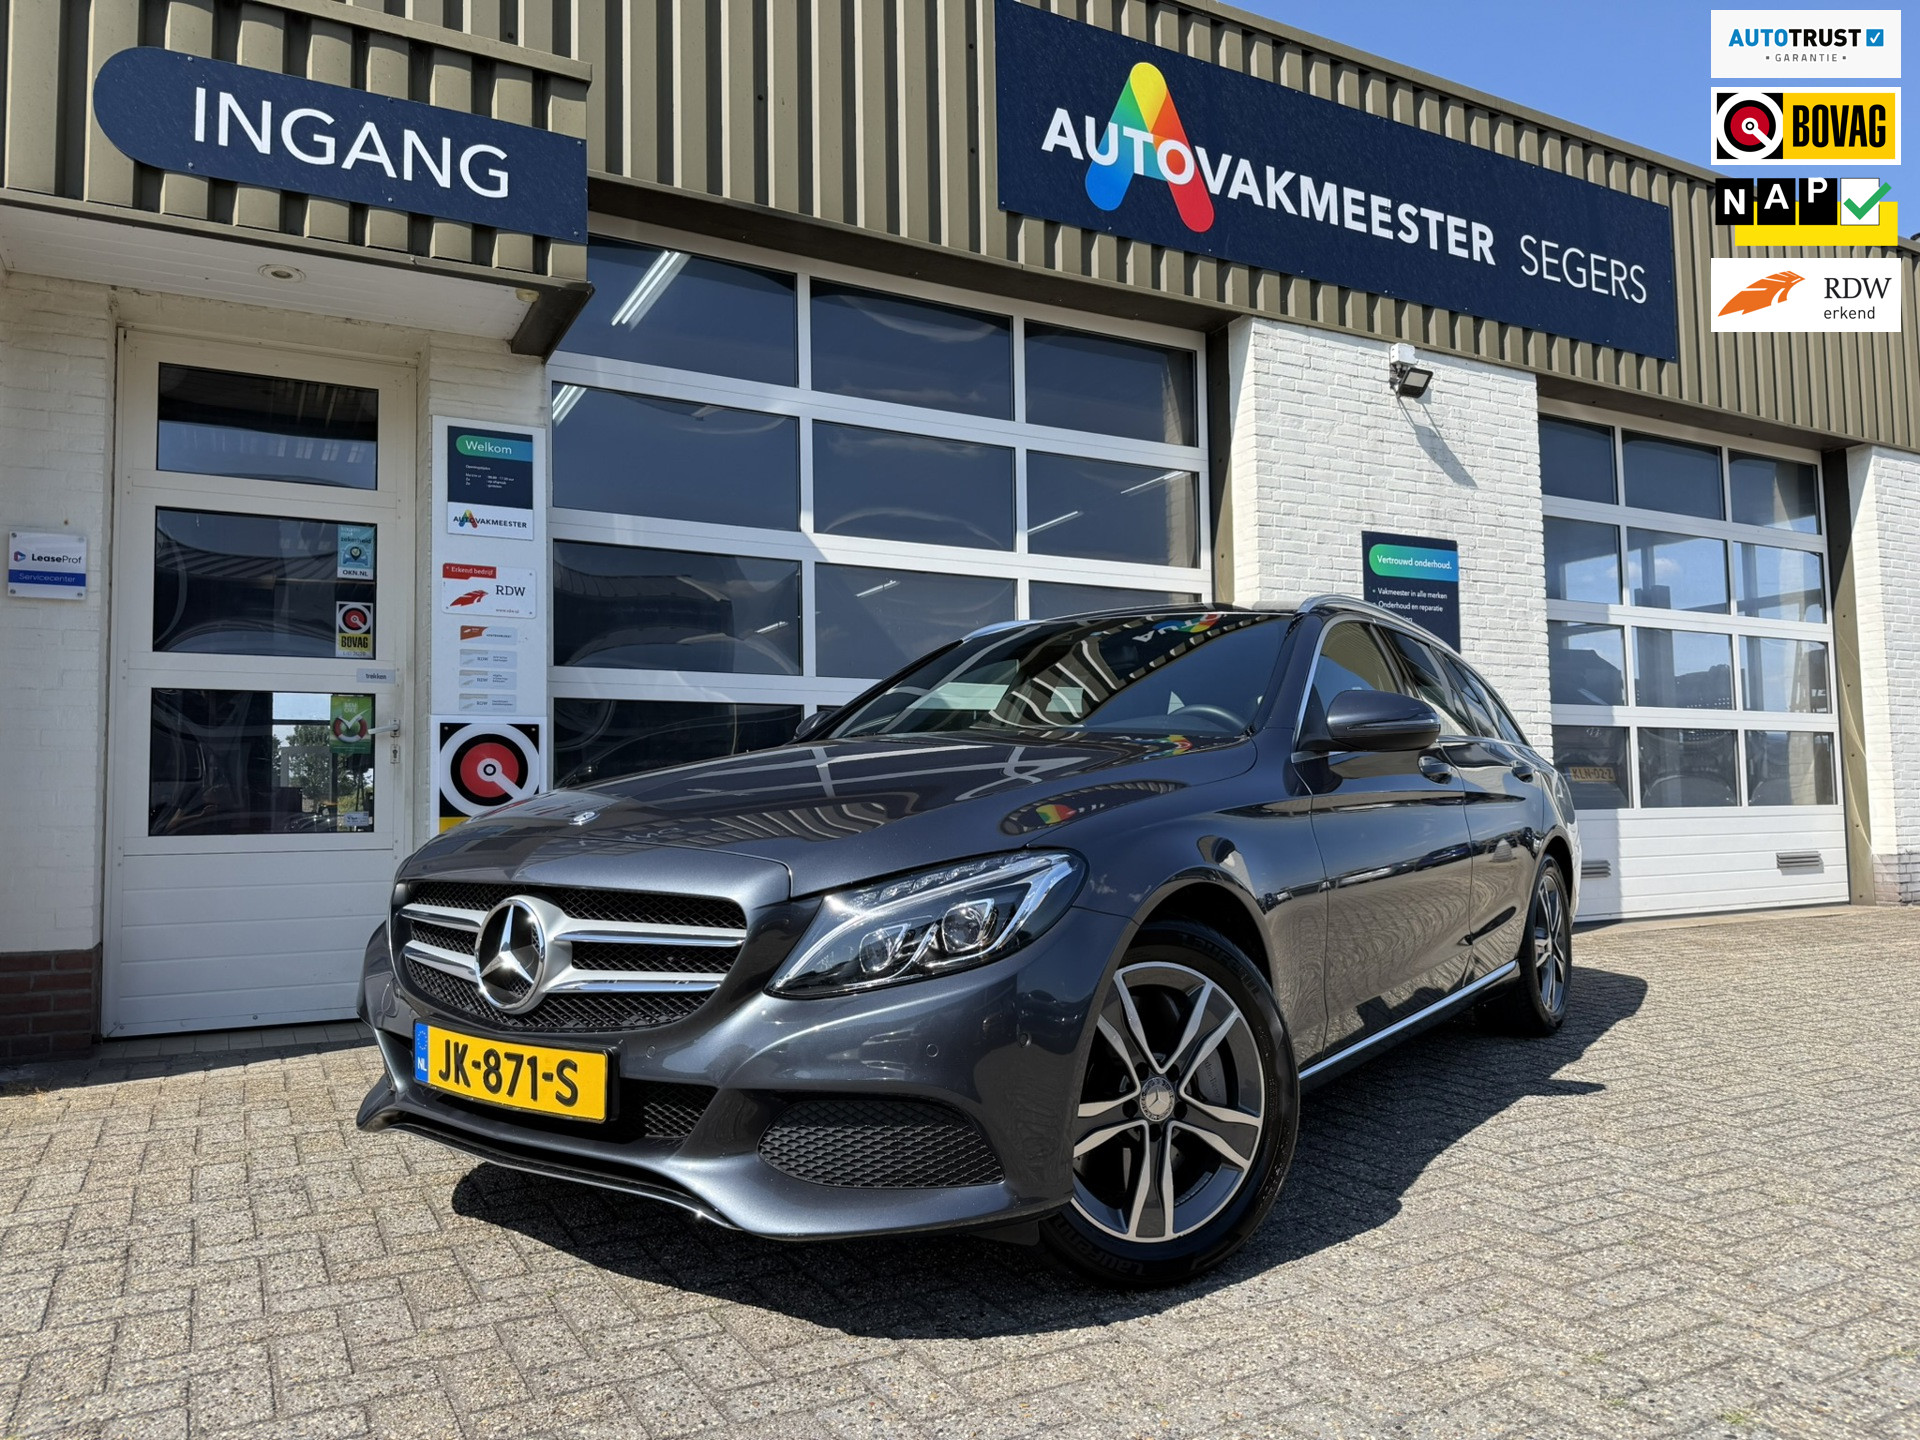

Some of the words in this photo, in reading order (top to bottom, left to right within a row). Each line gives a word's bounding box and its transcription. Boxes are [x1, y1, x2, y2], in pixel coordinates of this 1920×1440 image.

[193, 86, 510, 199] INGANG
[1040, 107, 1497, 266] AUTOVAKMEESTER
[1519, 234, 1648, 304] SEGERS
[465, 440, 512, 455] Welkom
[453, 516, 527, 528] AUTOVAKMEESTER
[31, 553, 82, 564] LeaseProf
[1377, 554, 1413, 566] Vertrouwd
[1414, 558, 1452, 570] onderhoud.
[451, 566, 473, 574] Erkend
[474, 568, 494, 576] bedrijf
[19, 573, 76, 583] Servicecenter
[496, 585, 526, 597] RDW
[1377, 587, 1410, 597] Vakmeester
[1417, 590, 1426, 598] alle
[1427, 592, 1447, 600] merken
[1378, 600, 1411, 610] Onderhoud
[1419, 603, 1443, 612] reparatie
[341, 635, 368, 648] BOVAG
[417, 1056, 428, 1072] NL
[438, 1039, 579, 1107] JK-871-S
